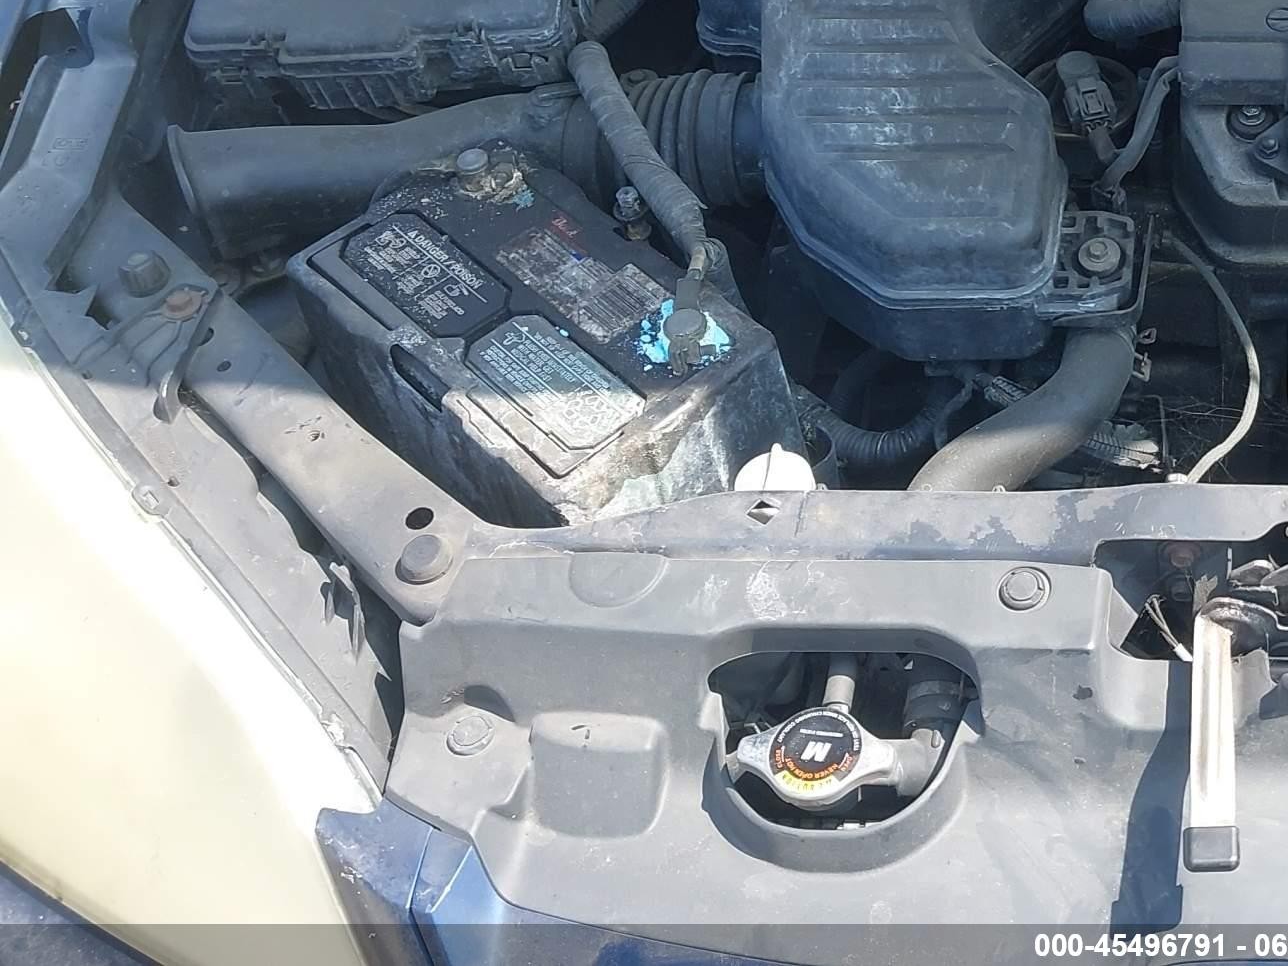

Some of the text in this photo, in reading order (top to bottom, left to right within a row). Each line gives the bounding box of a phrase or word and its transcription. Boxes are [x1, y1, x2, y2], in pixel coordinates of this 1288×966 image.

[416, 235, 449, 263] DANGER
[449, 262, 484, 290] POISON
[775, 749, 783, 769] CLOSE
[784, 756, 839, 779] NEVER OPEN HOT
